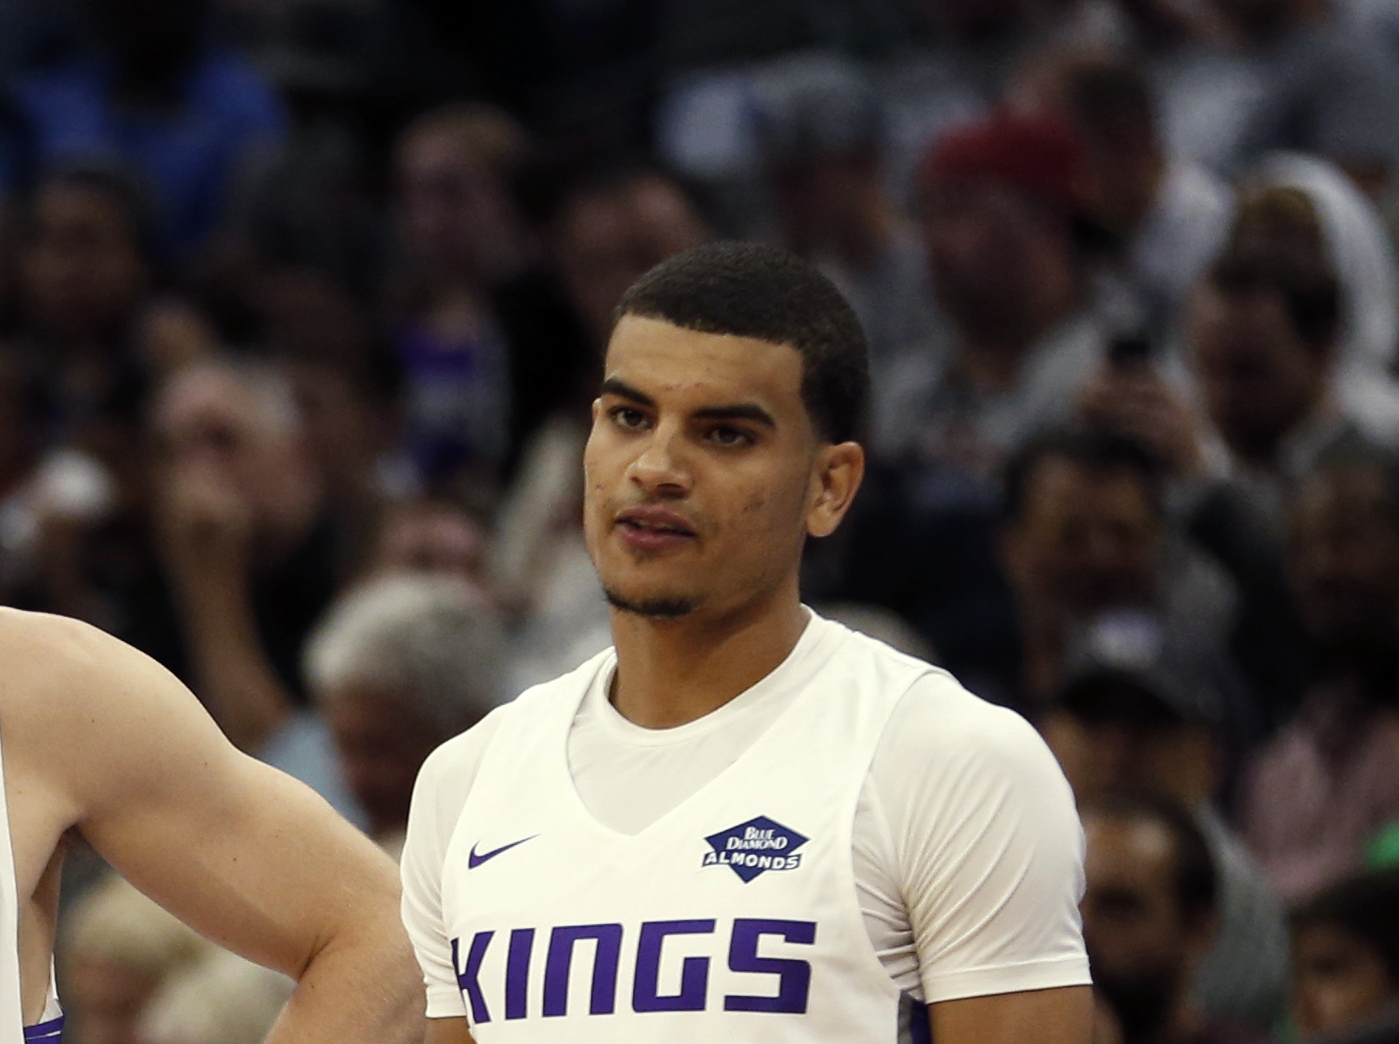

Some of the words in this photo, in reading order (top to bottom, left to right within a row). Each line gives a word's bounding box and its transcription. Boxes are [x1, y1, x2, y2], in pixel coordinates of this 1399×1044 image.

[743, 826, 776, 841] BLUE
[725, 836, 788, 851] DIAMOND
[704, 851, 799, 870] ALMONDS
[450, 918, 818, 1025] KINGS
